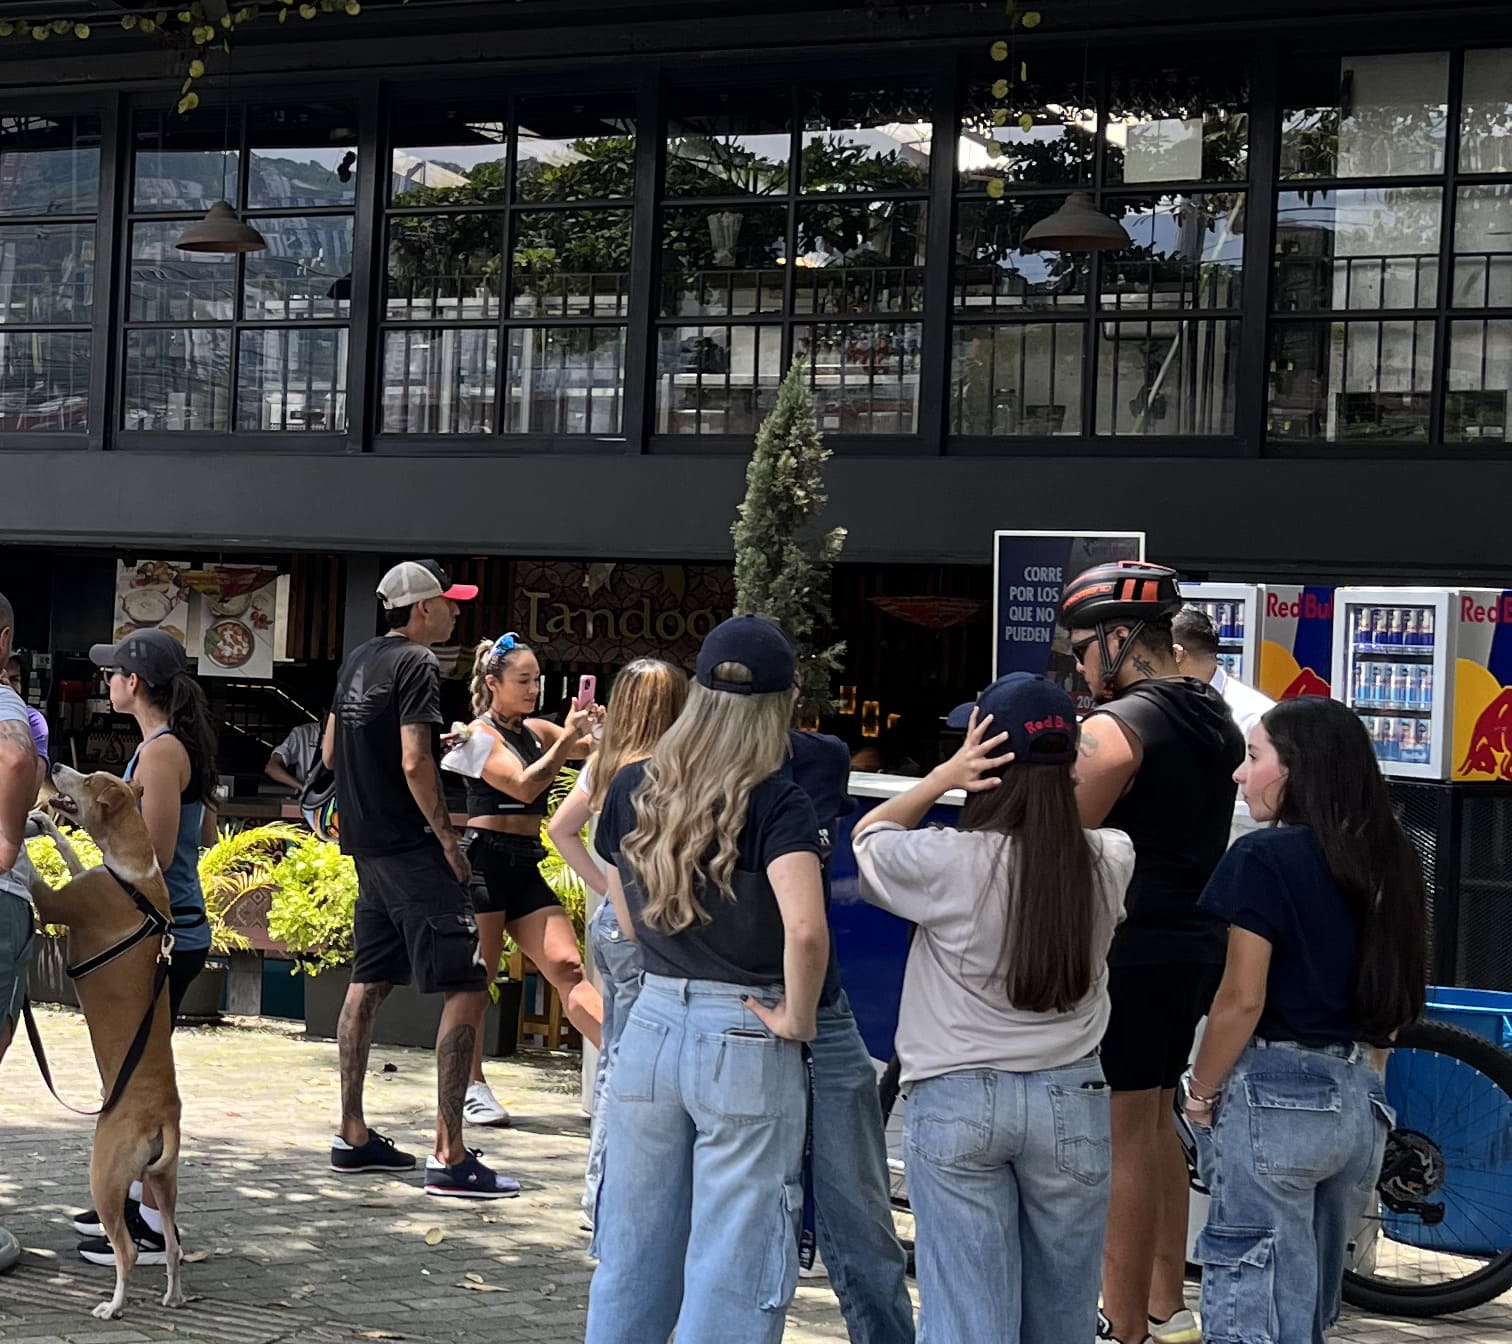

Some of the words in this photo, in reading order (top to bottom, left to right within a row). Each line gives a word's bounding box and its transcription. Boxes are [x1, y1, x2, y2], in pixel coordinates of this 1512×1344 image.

[1024, 566, 1063, 582] CORRE
[1009, 586, 1035, 602] POR
[1038, 587, 1059, 602] LOS
[1267, 592, 1302, 618] Red
[1460, 595, 1500, 623] Red
[1009, 606, 1033, 622] QUE
[1036, 607, 1054, 622] NO
[1005, 626, 1050, 642] PUEDEN
